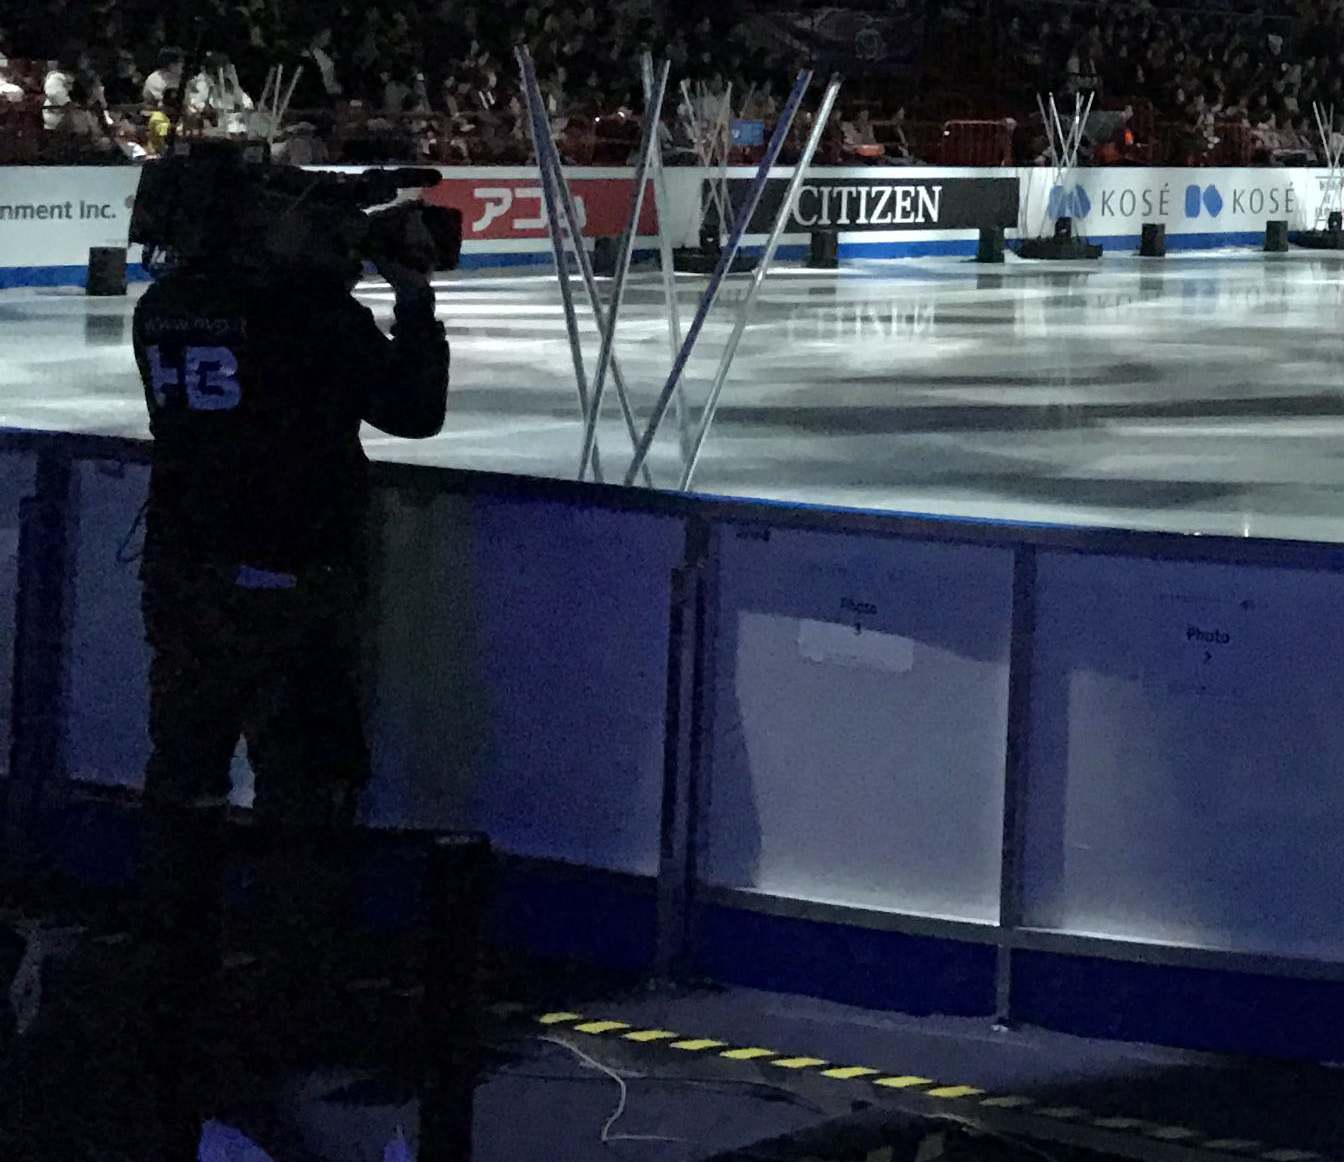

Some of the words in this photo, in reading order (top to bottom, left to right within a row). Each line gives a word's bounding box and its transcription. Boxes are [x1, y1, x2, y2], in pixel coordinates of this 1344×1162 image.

[79, 200, 116, 219] Inc.
[792, 185, 943, 226] CITIZEN
[1101, 183, 1170, 218] KOSÉ
[1232, 182, 1295, 214] KOSÉ
[1186, 626, 1231, 645] Photo
